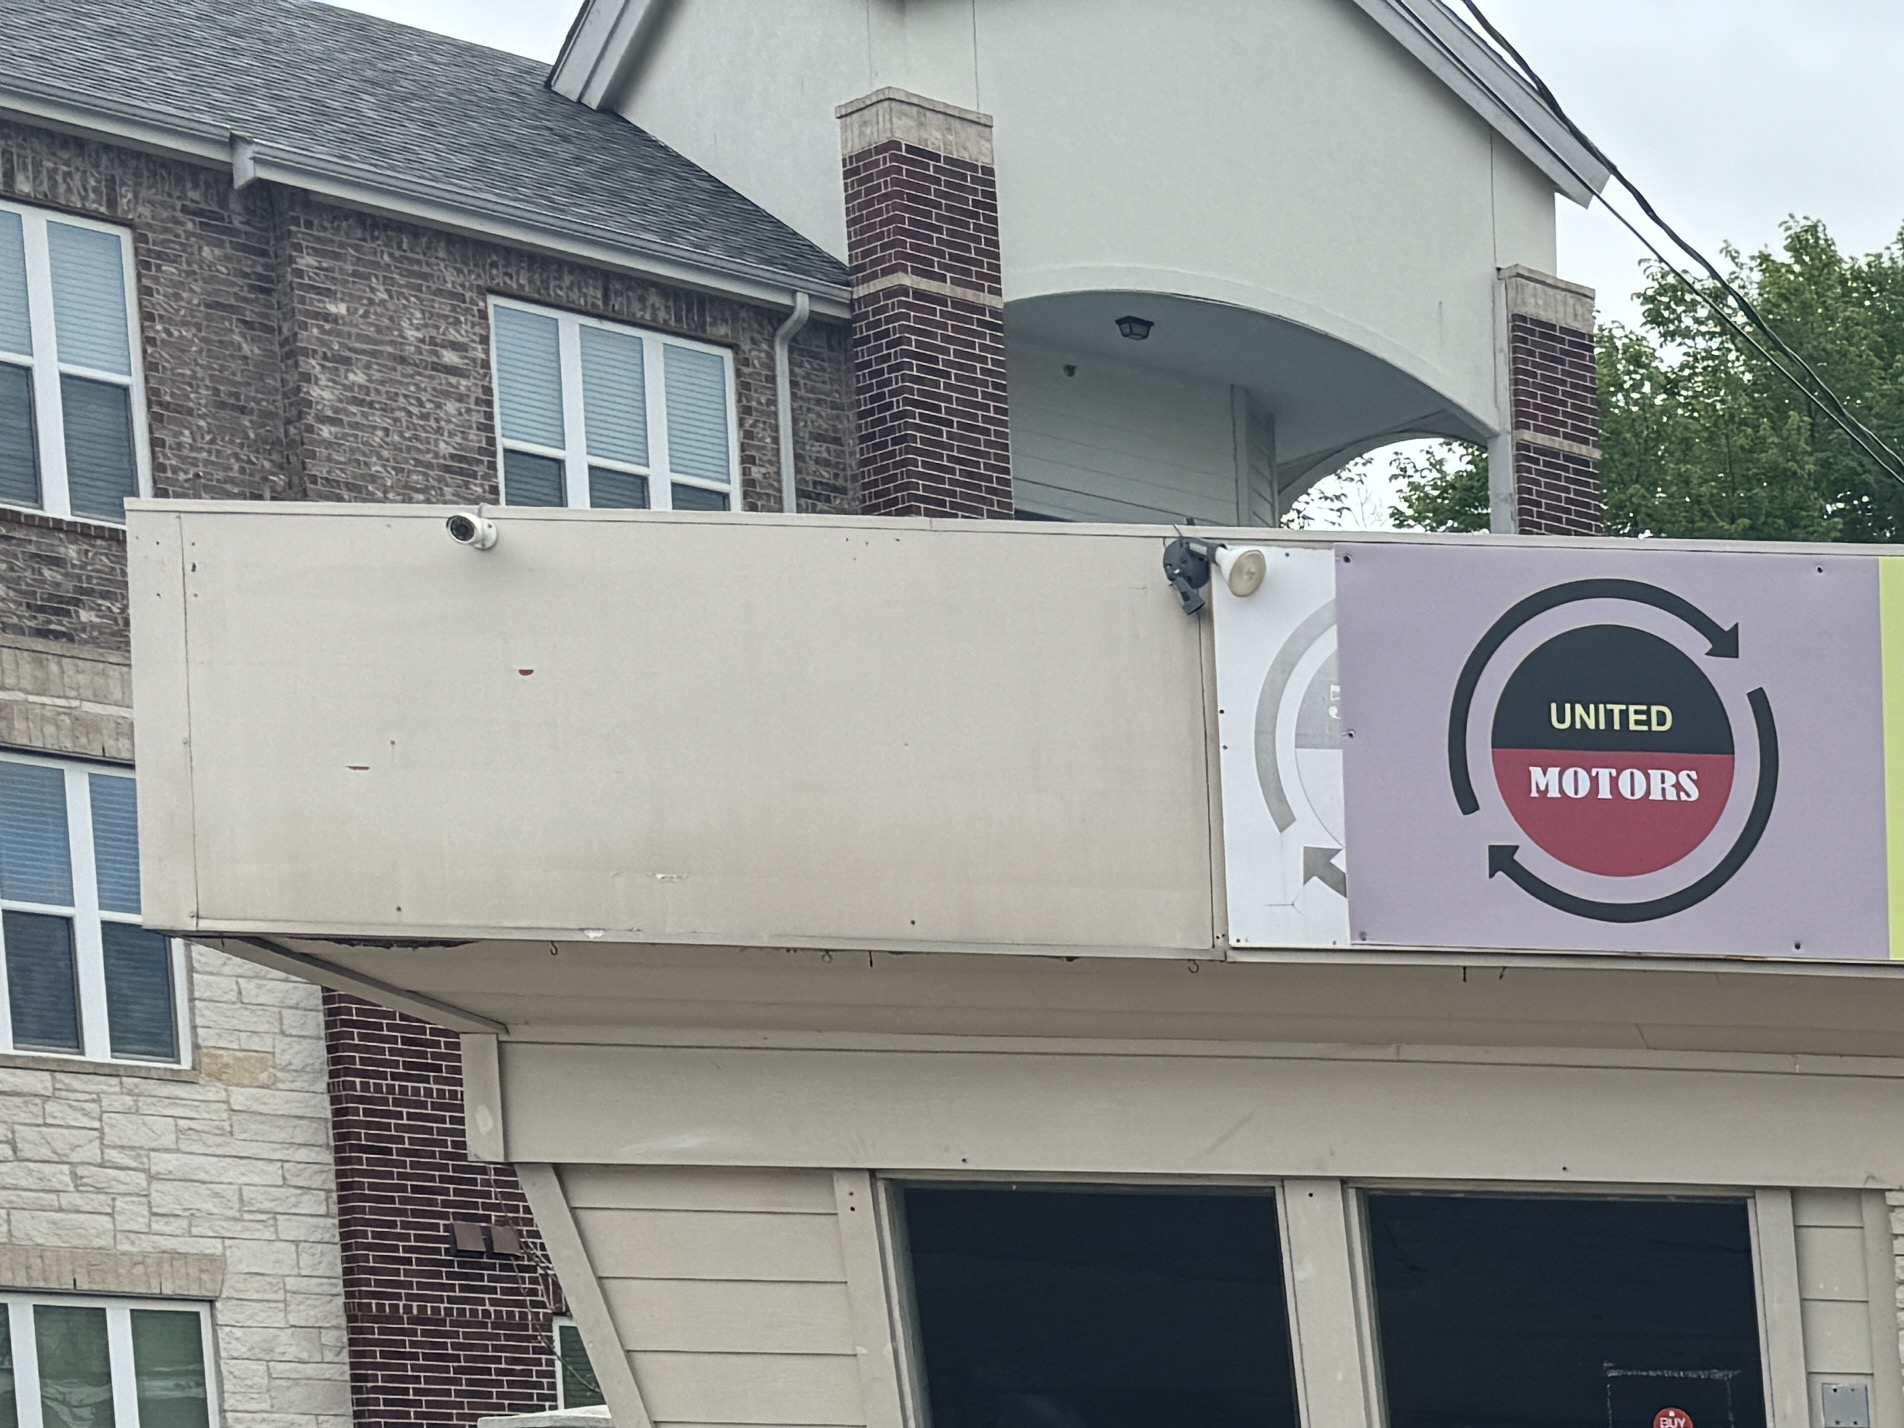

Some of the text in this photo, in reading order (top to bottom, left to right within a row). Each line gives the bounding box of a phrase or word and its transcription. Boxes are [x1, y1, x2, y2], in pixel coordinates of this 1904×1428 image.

[1549, 701, 1674, 732] UNITED
[1528, 765, 1700, 803] MOTORS
[1660, 1416, 1686, 1428] BUY
